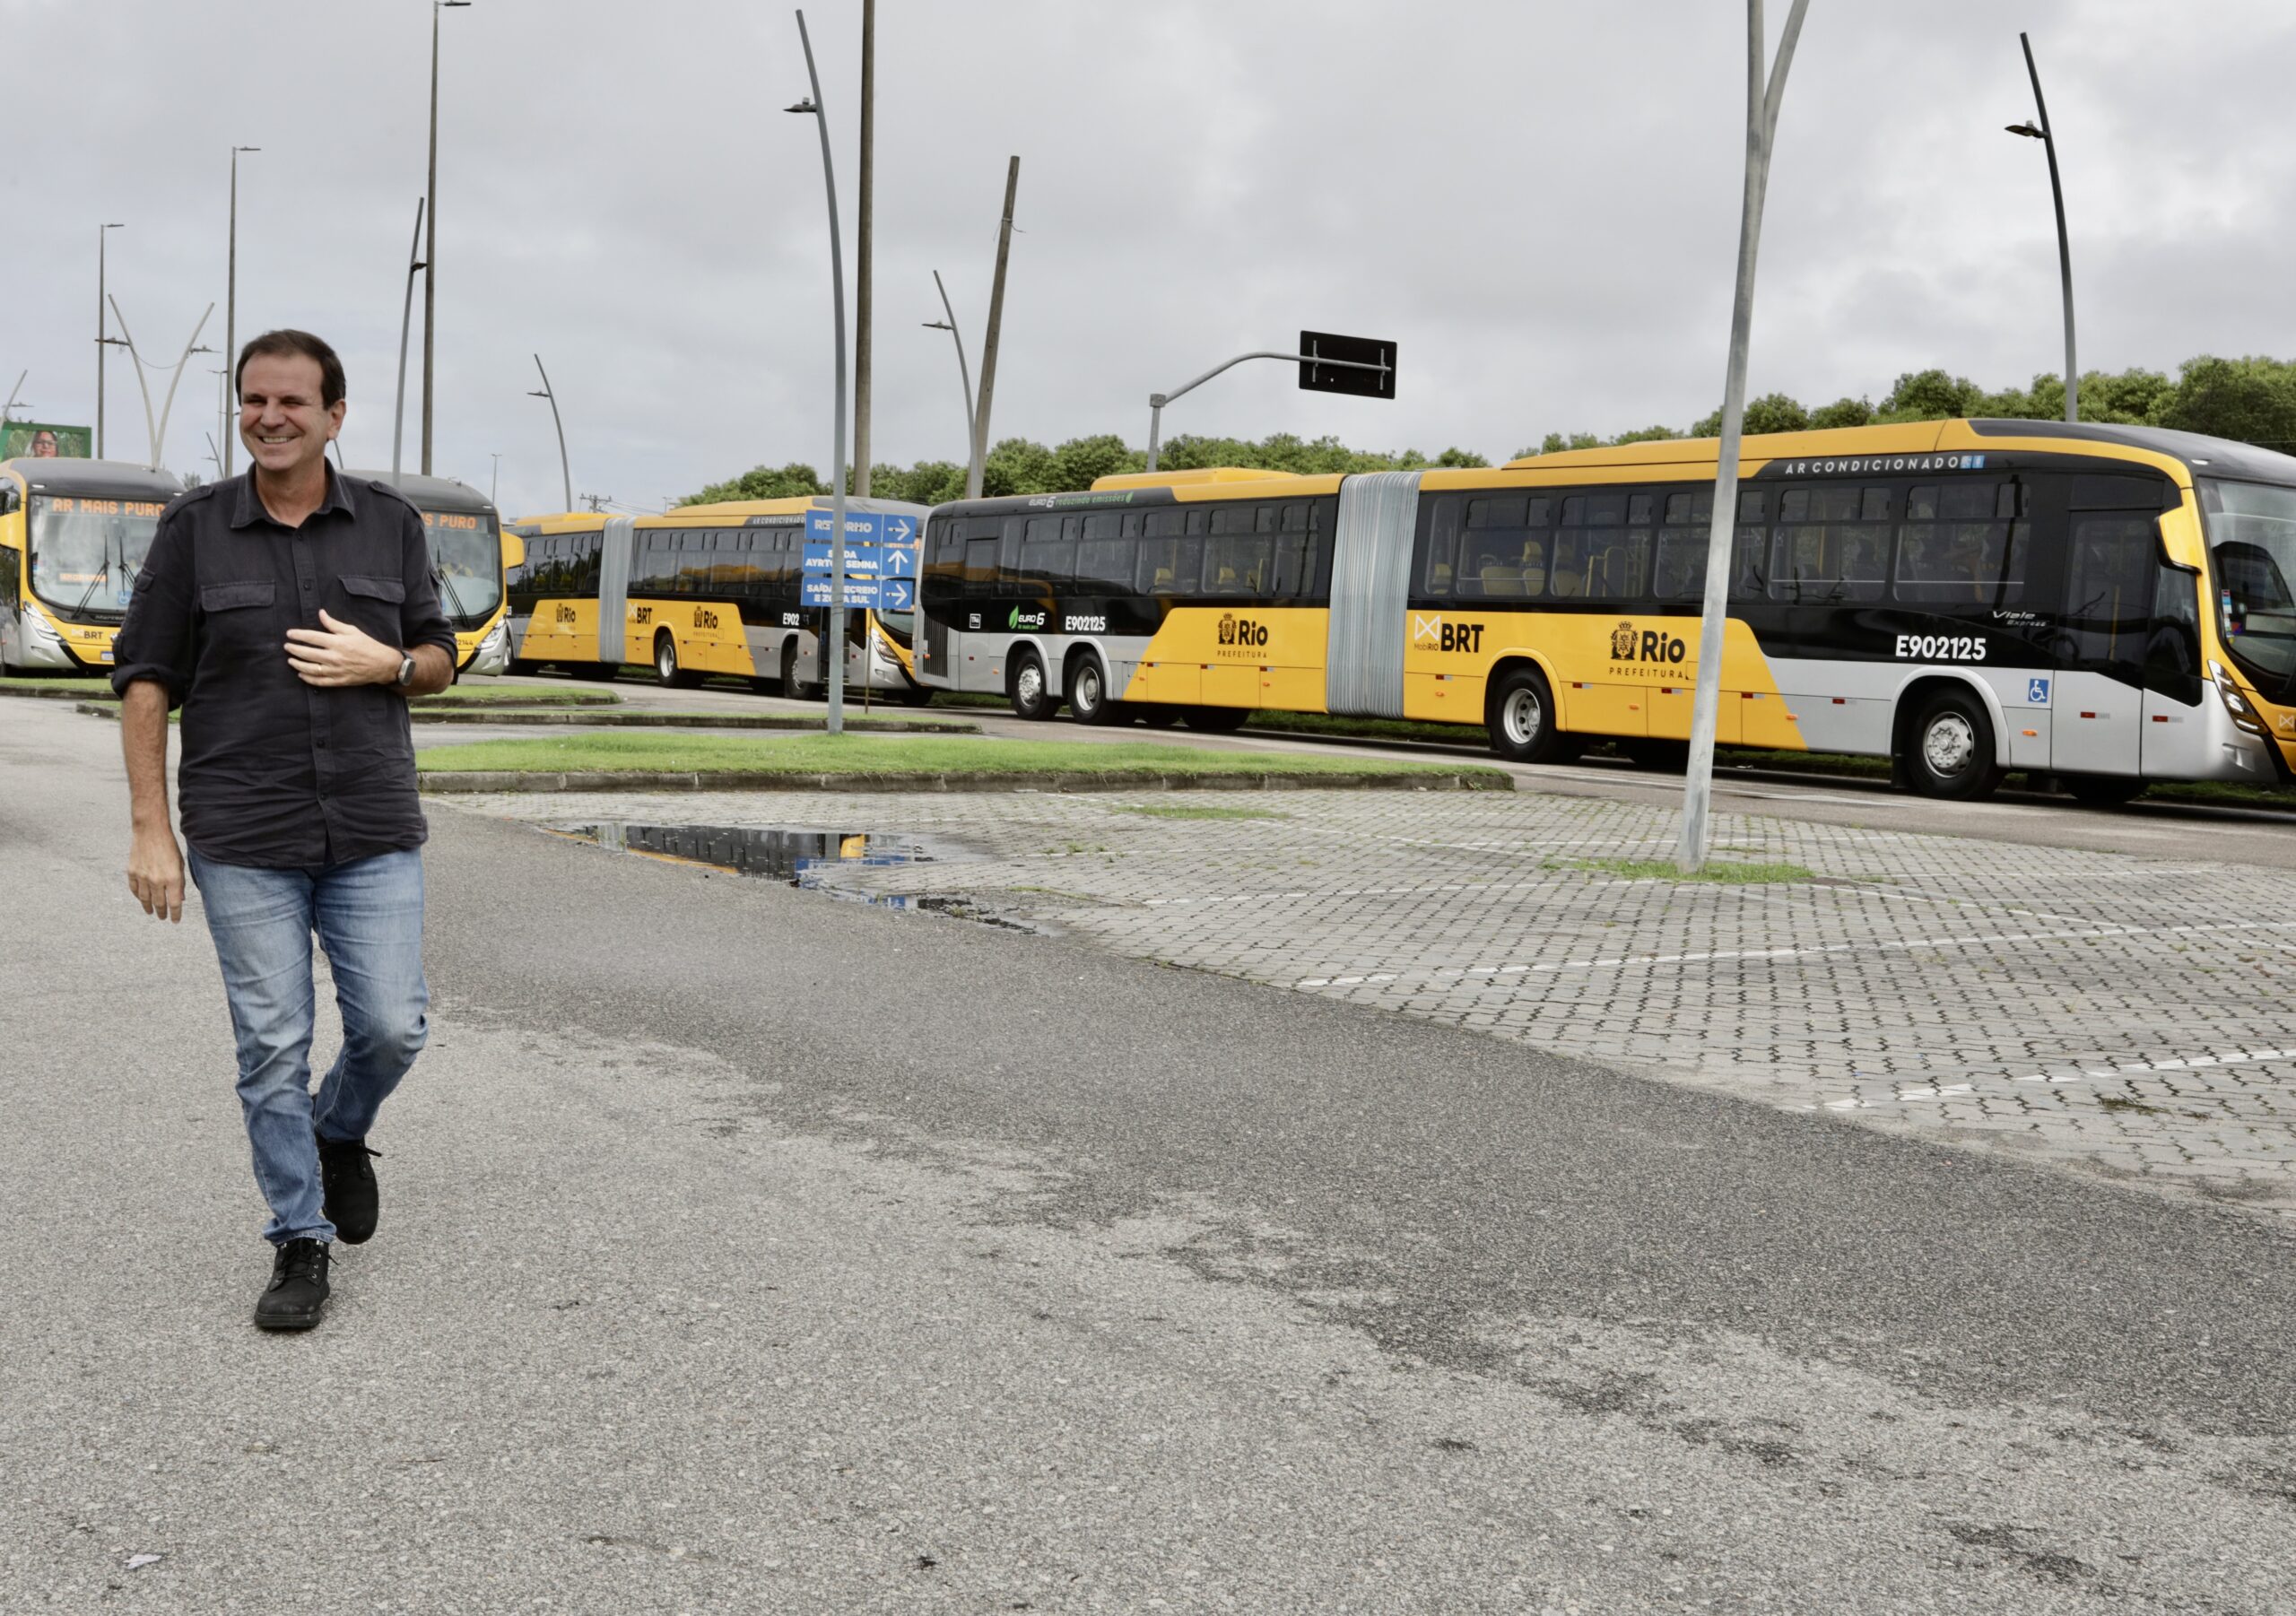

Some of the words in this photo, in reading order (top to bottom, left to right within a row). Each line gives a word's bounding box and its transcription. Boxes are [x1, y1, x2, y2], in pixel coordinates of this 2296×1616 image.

[1786, 462, 1805, 474] AR
[1812, 456, 1959, 474] CONDICIONADO
[52, 499, 74, 512] AR
[81, 500, 118, 515] MAIS
[439, 515, 476, 529] PURO
[814, 519, 873, 533] RERNO
[827, 549, 857, 559] SDA
[805, 558, 833, 568] AYRT
[845, 560, 878, 569] SENNA
[843, 586, 878, 595] ECREIO
[813, 594, 822, 603] E
[851, 595, 870, 604] SUL
[564, 606, 576, 622] Rio
[637, 607, 653, 624] BRT
[704, 611, 718, 630] Rio
[783, 613, 800, 626] E902
[1036, 613, 1046, 625] 6
[1065, 616, 1106, 631] E902125
[83, 630, 103, 639] BRT
[1238, 620, 1268, 647] Rio
[1440, 622, 1484, 653] BRT
[1217, 650, 1266, 658] PREFEITURA
[1640, 630, 1685, 664] Rio
[1895, 635, 1987, 661] E902125
[1609, 667, 1683, 679] PREFEITURA
